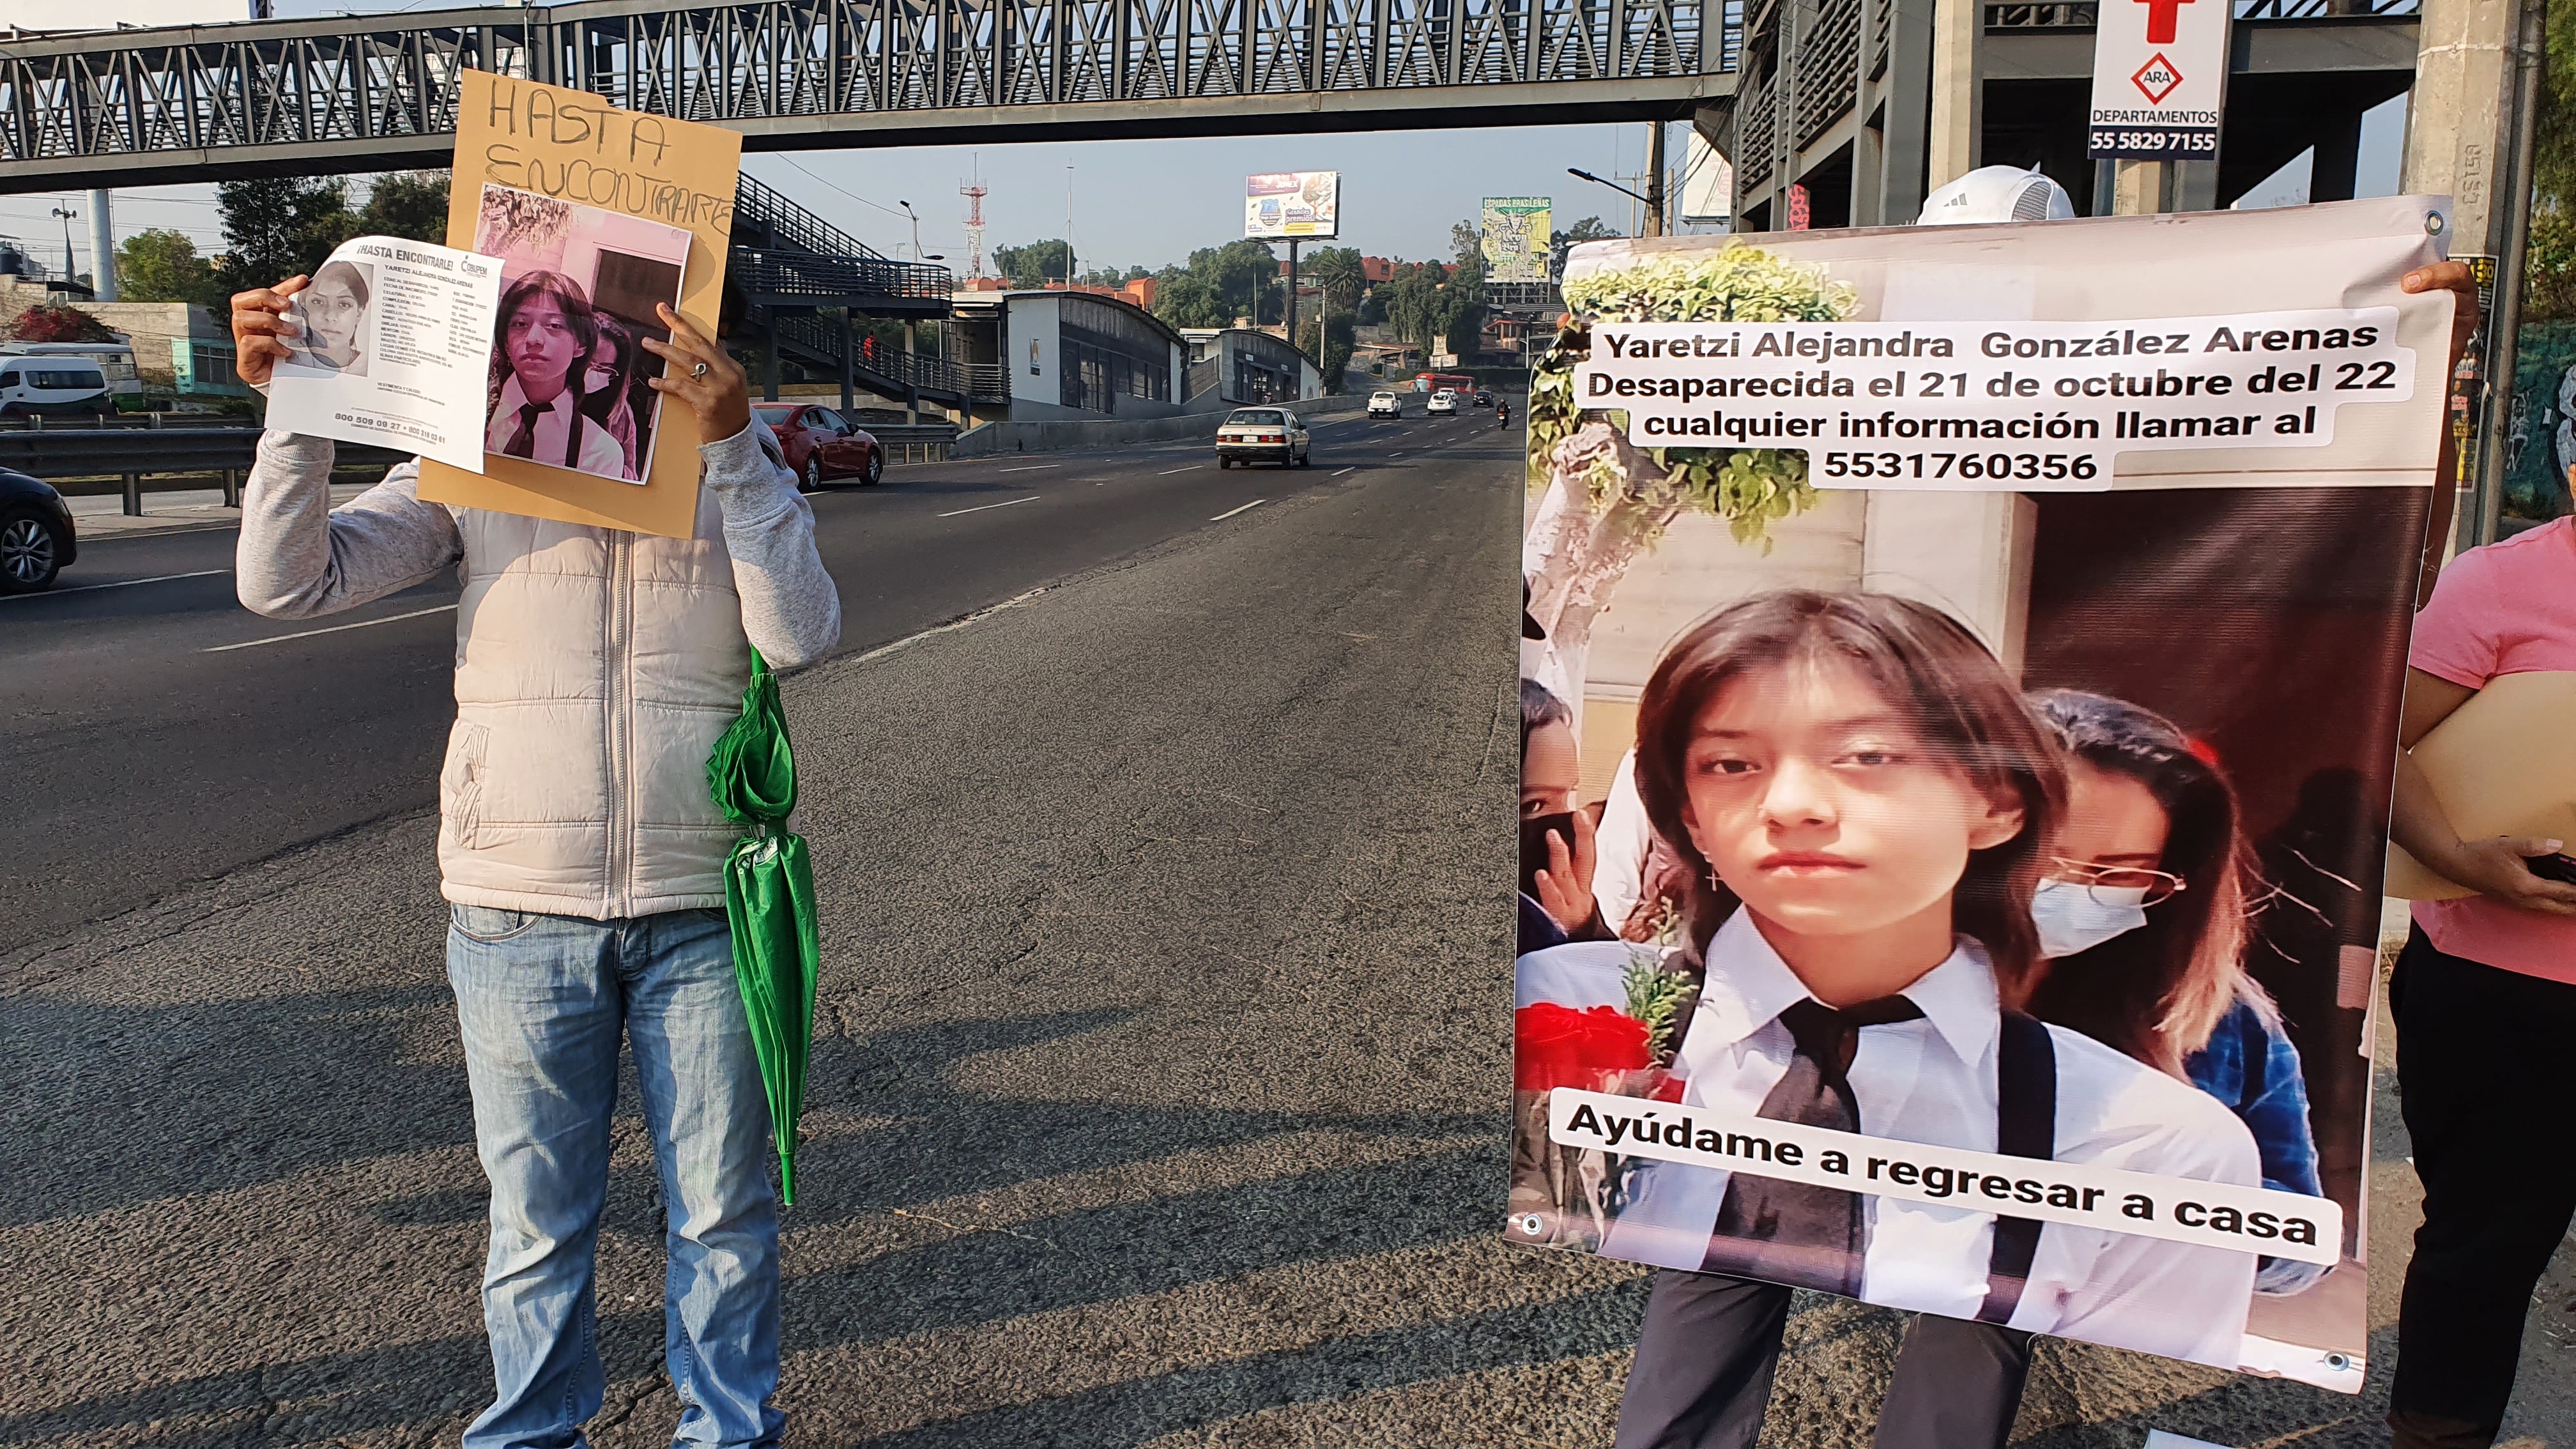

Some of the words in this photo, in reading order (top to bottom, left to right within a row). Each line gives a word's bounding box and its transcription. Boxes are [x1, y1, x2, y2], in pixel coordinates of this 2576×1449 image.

[2143, 72, 2171, 83] ARA
[489, 78, 671, 167] HASTA
[2092, 110, 2217, 123] DEPARTAMENTOS
[2090, 132, 2115, 150] 55
[2117, 132, 2166, 150] 5829
[2168, 133, 2216, 151] 7155
[486, 144, 734, 236] ENCONTRARTE
[385, 264, 410, 273] YARETZI
[396, 249, 454, 271] ENCONTRARLE!
[1605, 332, 1739, 358] Yaretzi
[1752, 331, 1954, 363] Alejandra
[1982, 329, 2189, 358] González
[2205, 326, 2379, 352] Arenas
[1588, 371, 1854, 403] Desaparecida
[1868, 371, 1905, 397] el
[1919, 372, 1966, 397] 21
[1986, 371, 2040, 397] de
[2054, 369, 2232, 397] octubre
[2247, 364, 2321, 394] del
[2335, 361, 2396, 390] 22
[335, 413, 353, 422] 800
[356, 417, 374, 425] 509
[1644, 411, 1827, 443] cualquier
[1840, 410, 2099, 439] información
[2115, 411, 2262, 439] llamar
[2274, 406, 2317, 434] al
[1825, 452, 2097, 480] 5531760356
[1567, 1104, 1804, 1166] Ayúdame
[1820, 1150, 1849, 1175] a
[1867, 1157, 2104, 1211] regresar
[2122, 1194, 2154, 1220] a
[2174, 1201, 2316, 1246] casa
